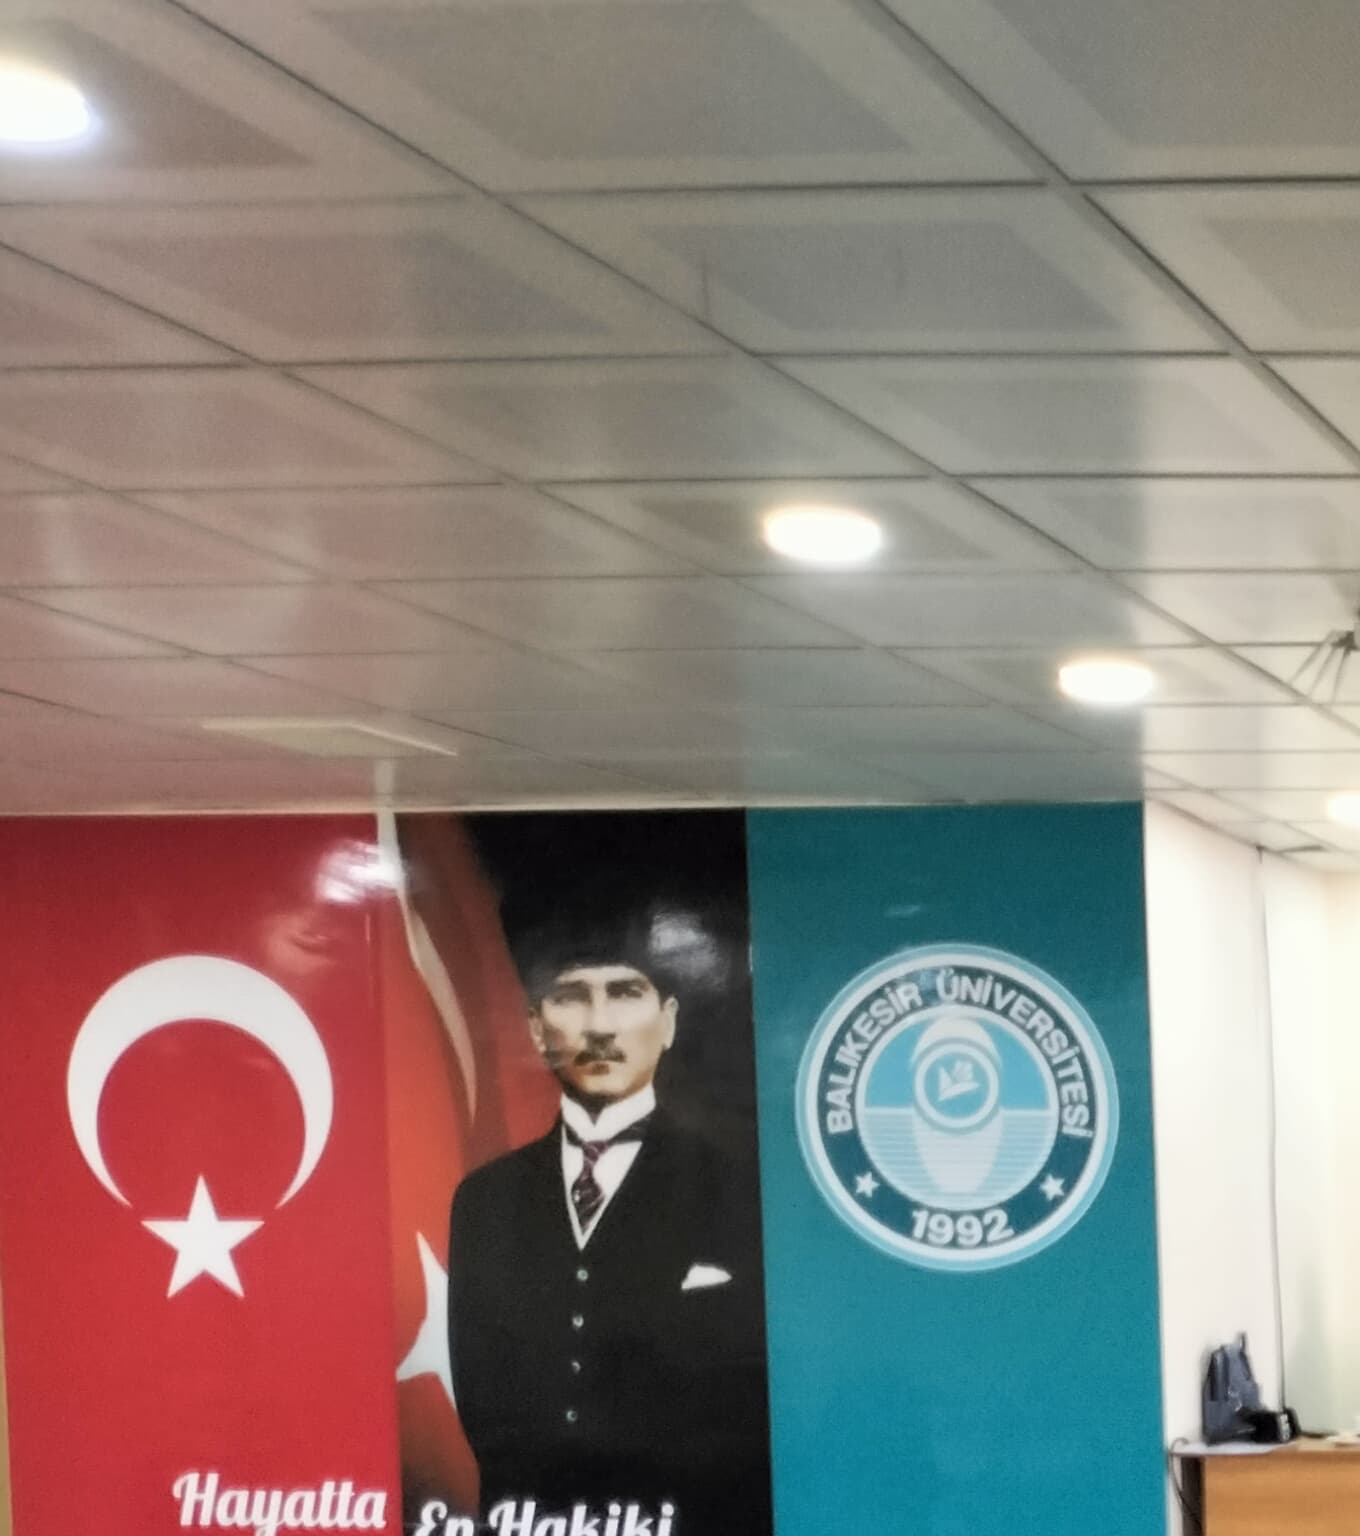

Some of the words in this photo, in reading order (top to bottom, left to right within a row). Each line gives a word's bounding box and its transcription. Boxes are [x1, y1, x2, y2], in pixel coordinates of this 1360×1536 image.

[825, 980, 923, 1135] BALIKESİR
[936, 968, 1093, 1139] ÜNİVERSİTESİ
[911, 1209, 1015, 1245] 1992
